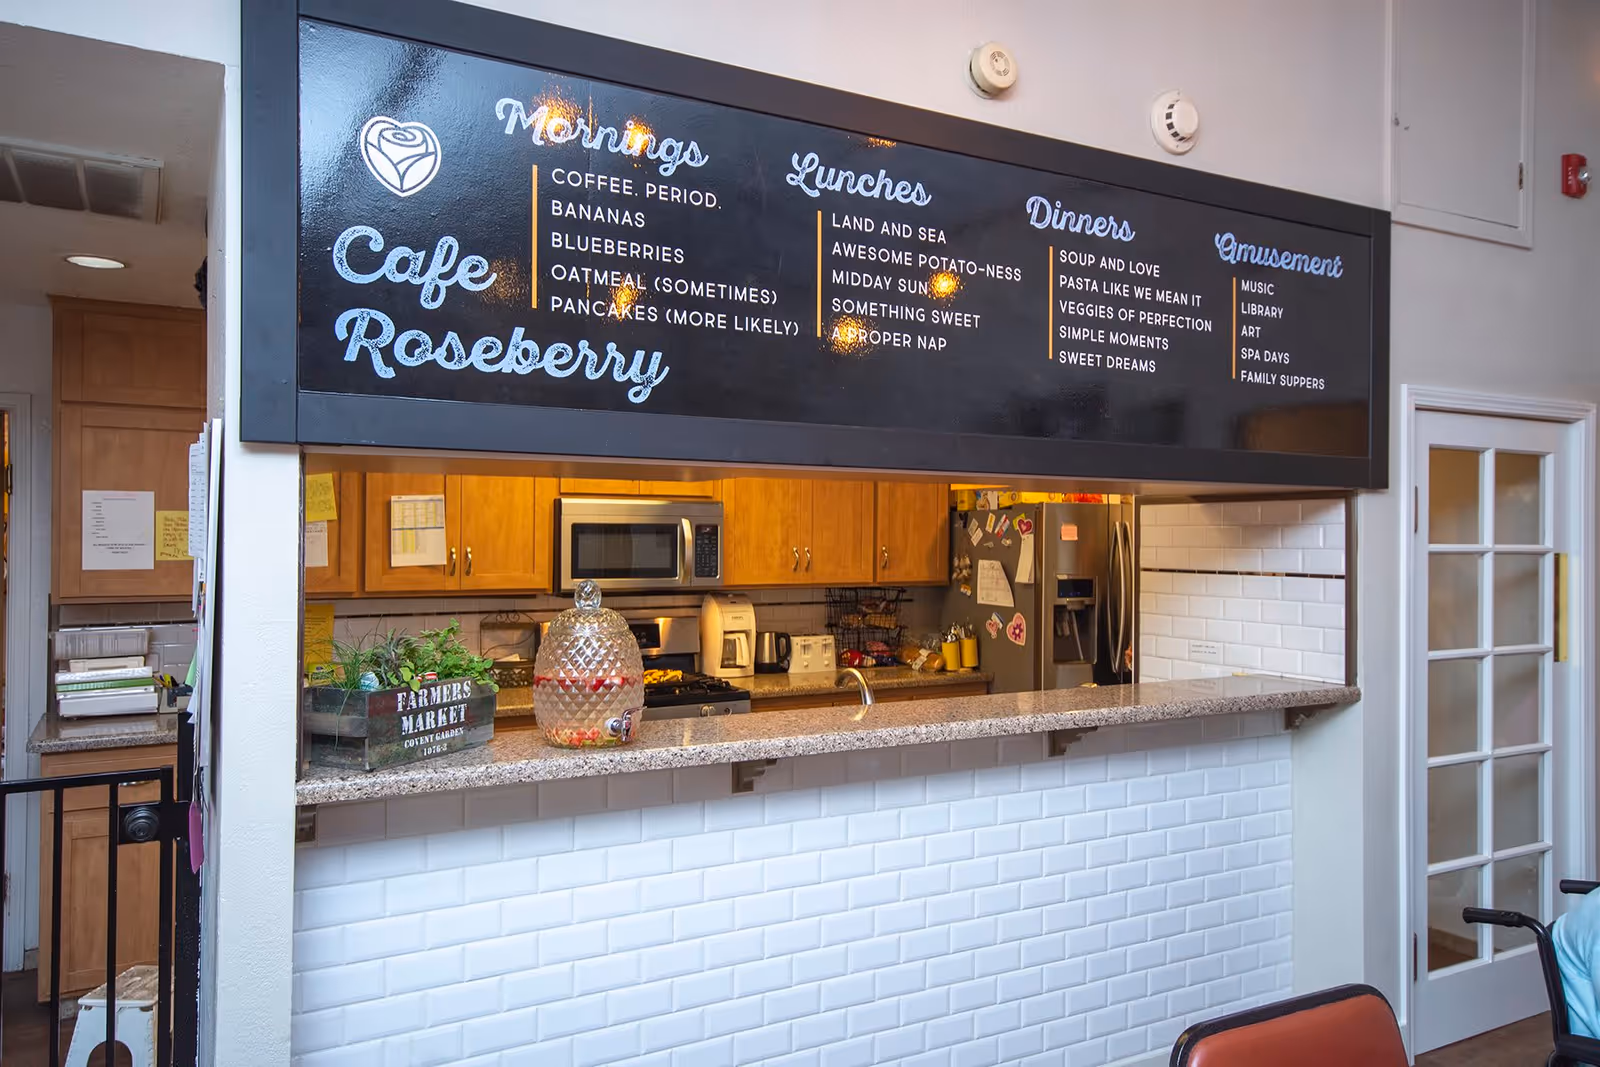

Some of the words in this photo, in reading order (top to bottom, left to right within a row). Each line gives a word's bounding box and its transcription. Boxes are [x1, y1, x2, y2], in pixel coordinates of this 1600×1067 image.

[495, 98, 709, 177] Mornings
[552, 168, 638, 196] COFFEE.
[646, 183, 722, 209] PERIOD.
[785, 152, 933, 206] Lunches
[551, 200, 645, 228] BANANAS
[832, 213, 875, 232] LAND
[880, 221, 913, 238] AND
[918, 227, 947, 244] SEA
[1026, 195, 1136, 242] Dinners
[551, 232, 684, 264] BLUEBERRIES
[832, 242, 913, 266] AWESOME
[918, 253, 1022, 282] POTATO-NESS
[1059, 249, 1096, 267] SOUP
[1099, 256, 1125, 272] AND
[1129, 260, 1160, 278] LOVE
[1214, 232, 1343, 278] Amusement
[332, 225, 498, 310] Cafe
[832, 270, 892, 290] MIDDAY
[898, 278, 928, 295] SUN
[551, 264, 647, 290] OATMEAL
[654, 276, 778, 305] (SOMETIMES)
[1059, 275, 1098, 293] PASTA
[1103, 281, 1129, 297] LIKE
[1134, 286, 1152, 300] WE
[1156, 289, 1188, 306] MEAN
[1191, 294, 1202, 307] IT
[1241, 279, 1275, 295] MUSIC
[551, 296, 658, 322] PANCAKES
[666, 308, 727, 329] (MORE
[734, 315, 799, 336] LIKELY)
[832, 298, 926, 322] SOMETHING
[931, 310, 981, 329] SWEET
[1059, 300, 1114, 319] VEGGIES
[1118, 308, 1135, 322] OF
[1139, 311, 1212, 332] PERFECTION
[1241, 302, 1284, 319] LIBRARY
[831, 326, 841, 340] A
[848, 328, 911, 347] PROPER
[917, 335, 947, 351] NAP
[1059, 325, 1105, 343] SIMPLE
[1109, 331, 1169, 350] MOMENTS
[1241, 325, 1261, 338] ART
[334, 307, 670, 404] Roseberry
[1059, 350, 1102, 367] SWEET
[1106, 355, 1156, 373] DREAMS
[1241, 347, 1261, 361] SPA
[1264, 350, 1290, 364] DAYS
[1240, 370, 1277, 385] FAMILY
[1280, 375, 1325, 390] SUPPERS
[396, 680, 472, 712] FARMERS
[401, 703, 467, 736] MARKET
[404, 733, 434, 748] COVENT
[435, 727, 464, 741] GARDEN
